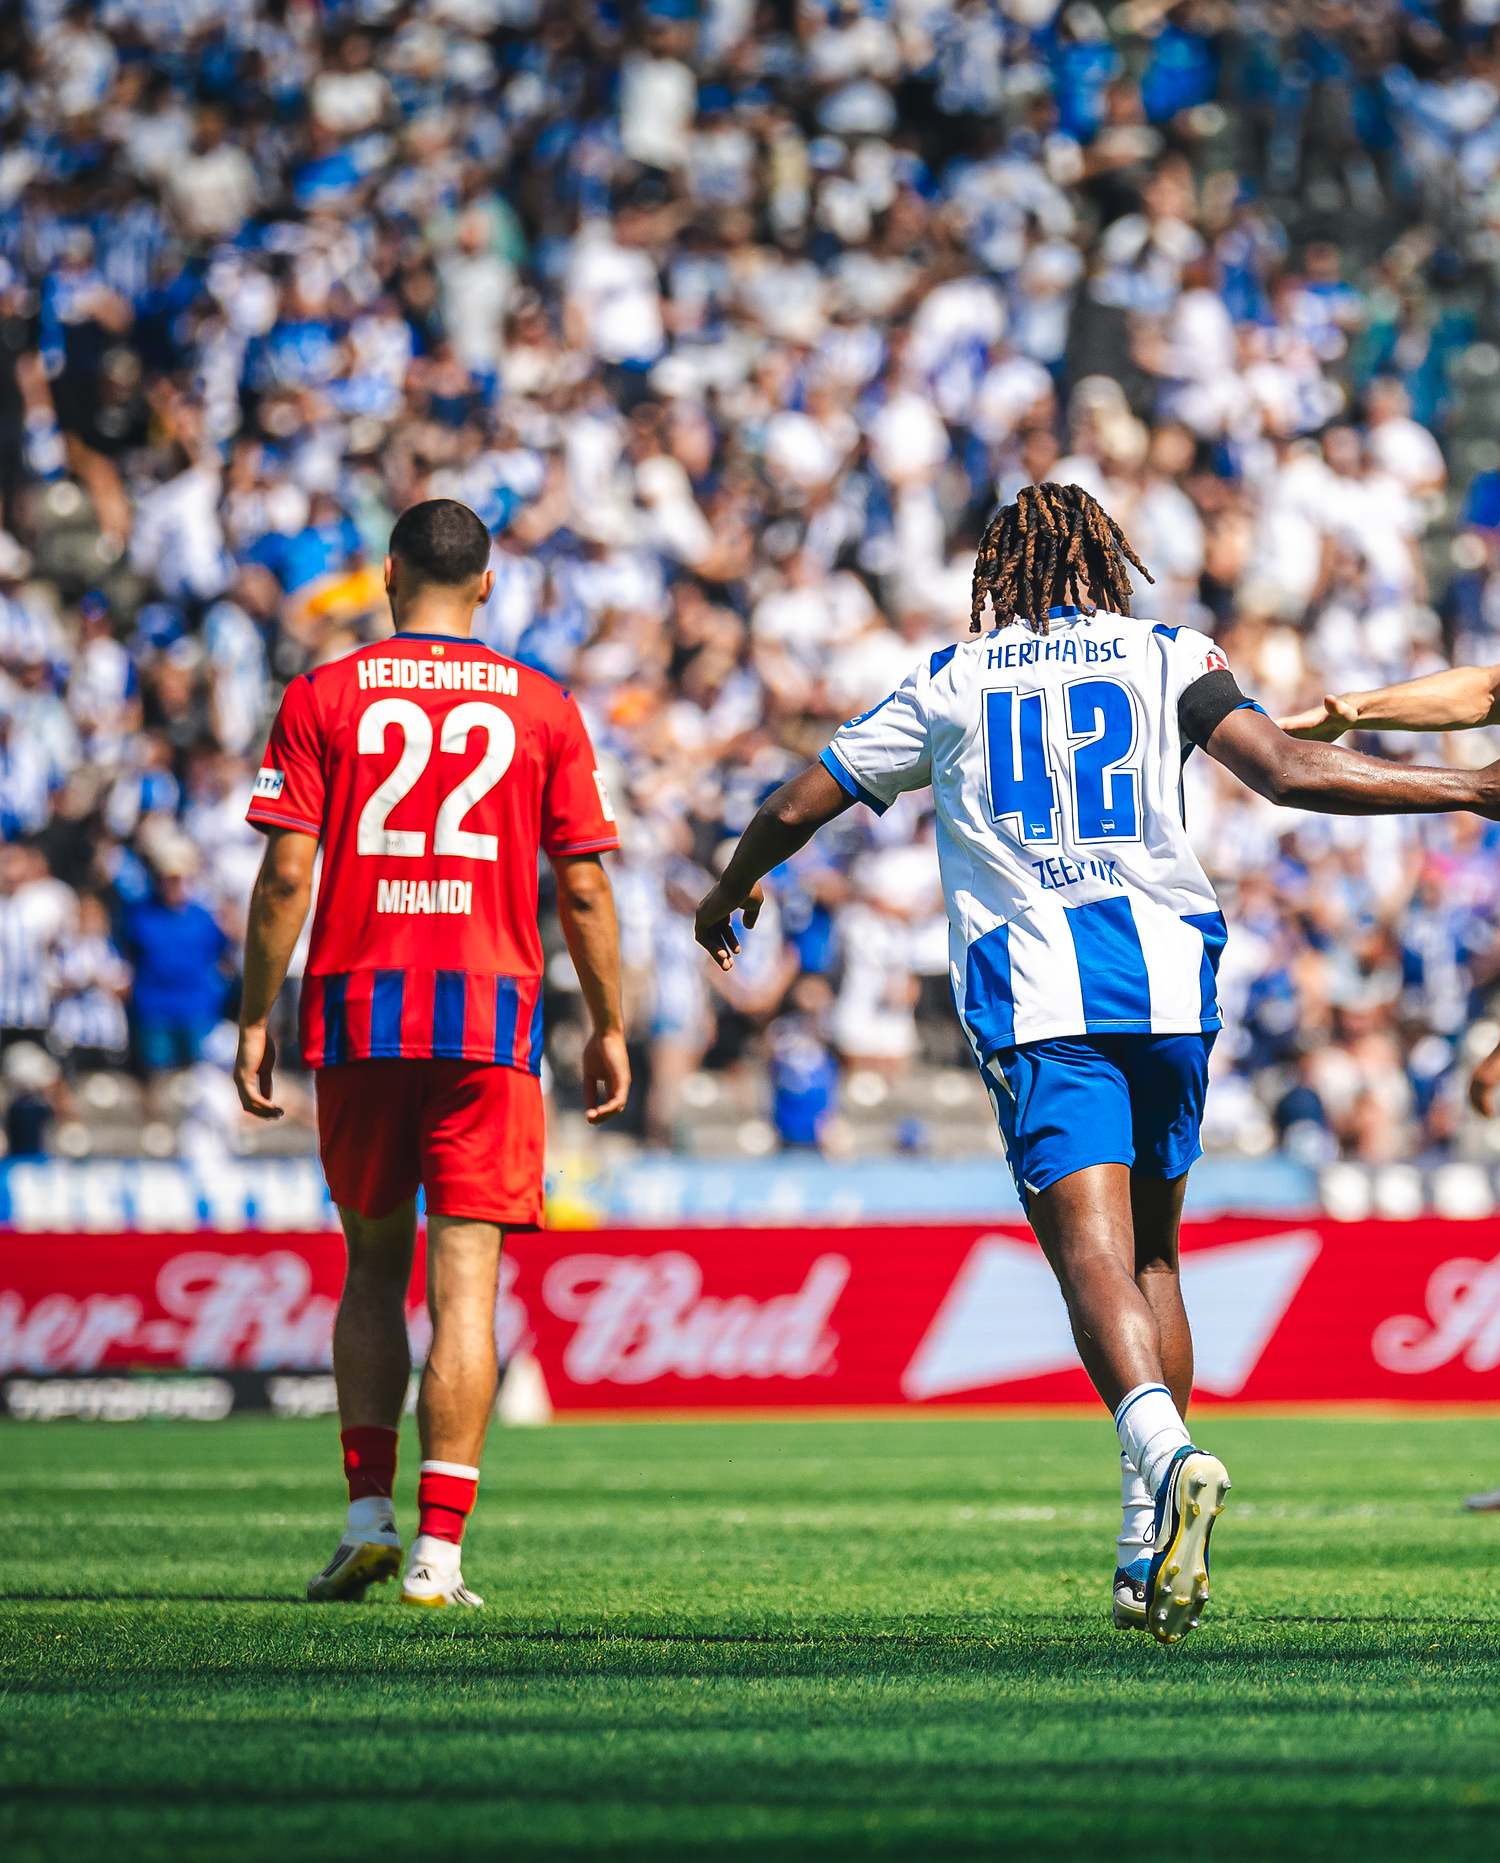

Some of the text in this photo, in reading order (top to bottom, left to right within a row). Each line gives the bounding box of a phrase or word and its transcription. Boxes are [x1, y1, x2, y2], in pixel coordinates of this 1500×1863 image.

[357, 658, 518, 697] HEIDENHEIM
[987, 637, 1127, 670] HERTHA BSC
[357, 698, 516, 861] 22
[982, 675, 1142, 847] 42
[377, 879, 473, 915] MHAMDI
[543, 1250, 851, 1385] Bud
